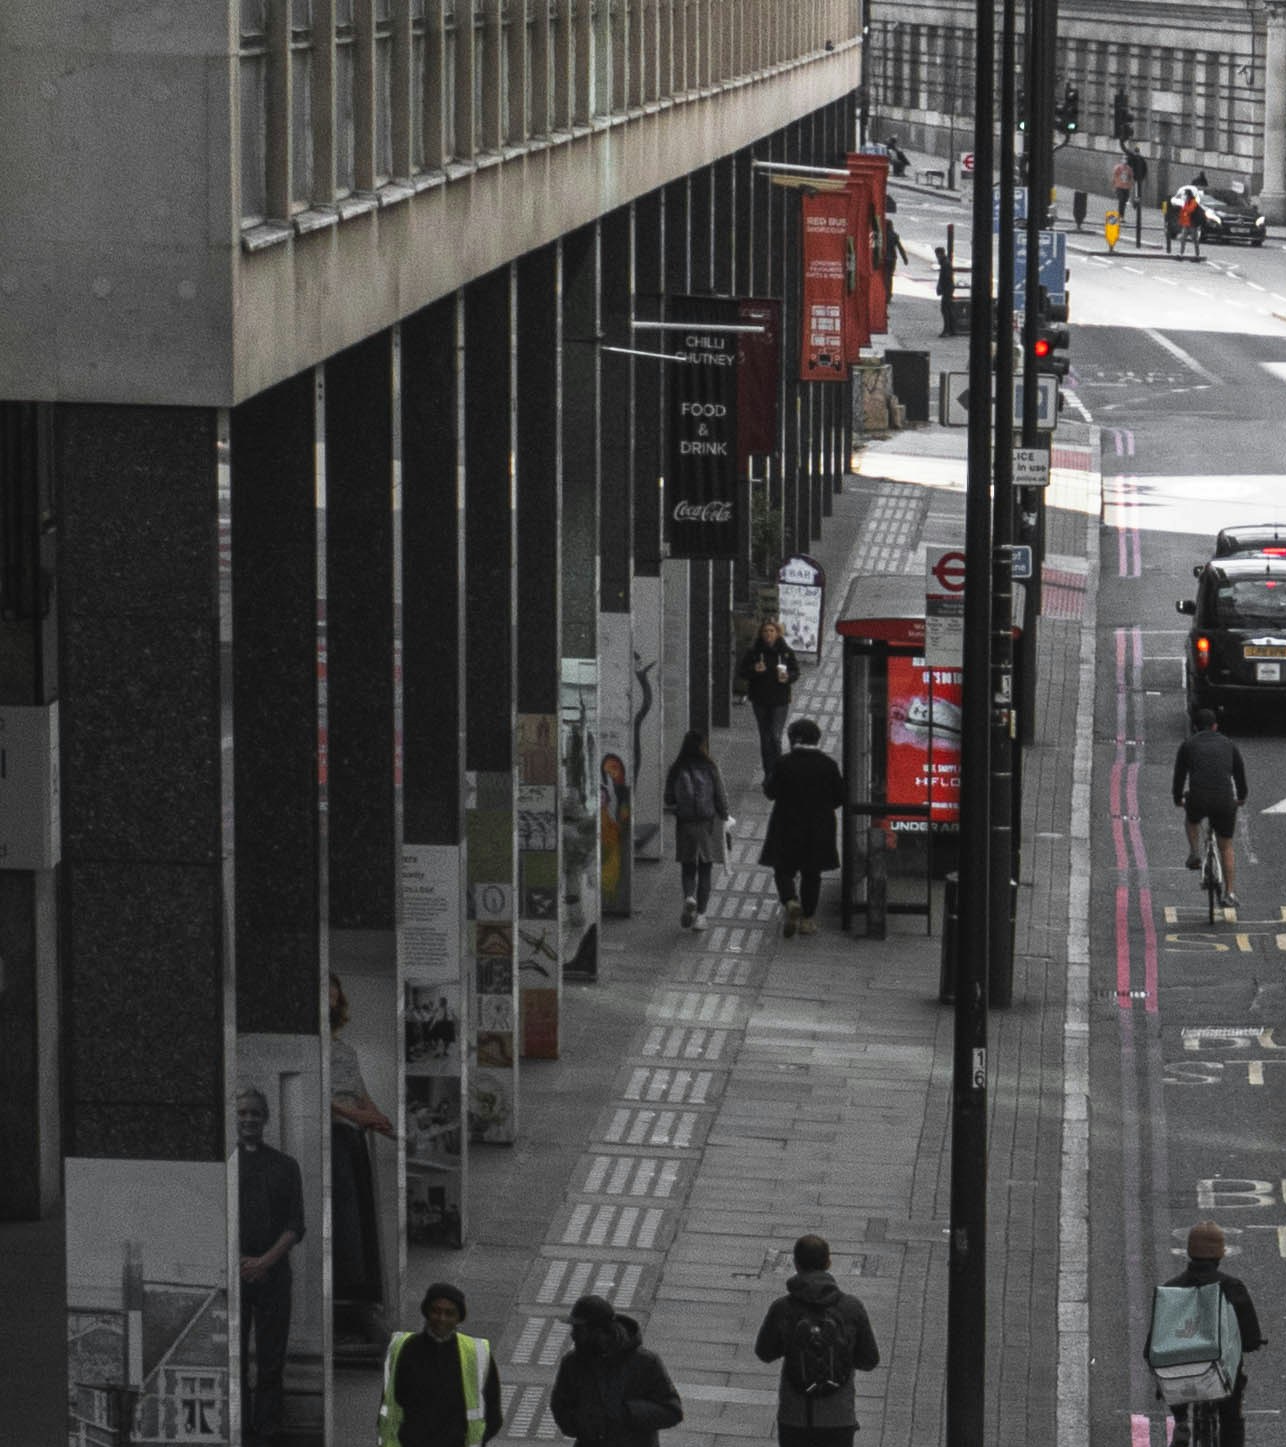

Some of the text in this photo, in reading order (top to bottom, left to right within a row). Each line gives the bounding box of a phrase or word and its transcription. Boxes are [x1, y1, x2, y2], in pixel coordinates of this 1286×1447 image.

[685, 336, 725, 350] CHILLI
[675, 352, 735, 366] CHUTNEY
[681, 403, 726, 417] FOOD
[698, 423, 709, 437] &
[680, 442, 727, 456] DRINK
